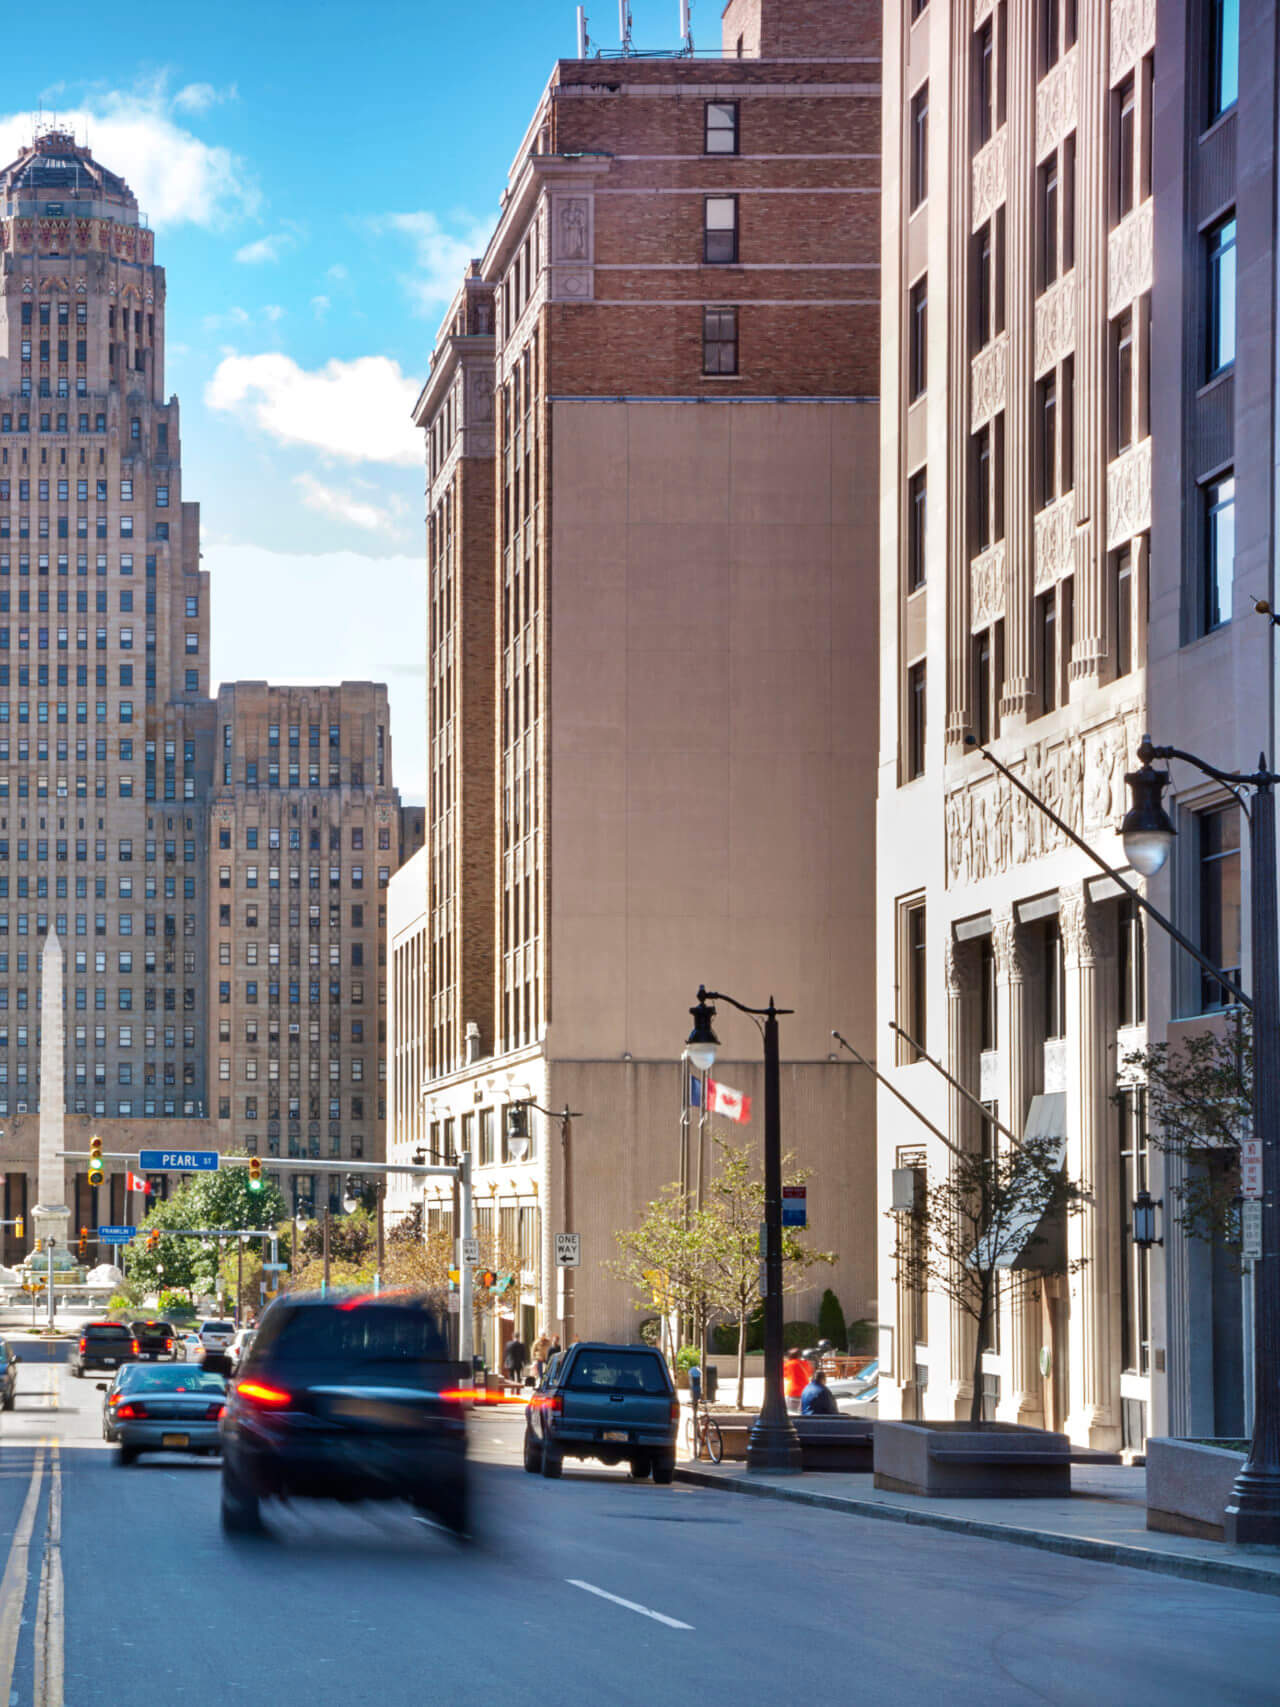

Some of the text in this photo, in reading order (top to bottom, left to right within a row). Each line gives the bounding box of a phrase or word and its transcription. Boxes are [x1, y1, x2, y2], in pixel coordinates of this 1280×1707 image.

[162, 1154, 212, 1167] PEARL ST
[558, 1235, 577, 1244] ONE
[558, 1245, 577, 1254] WAY
